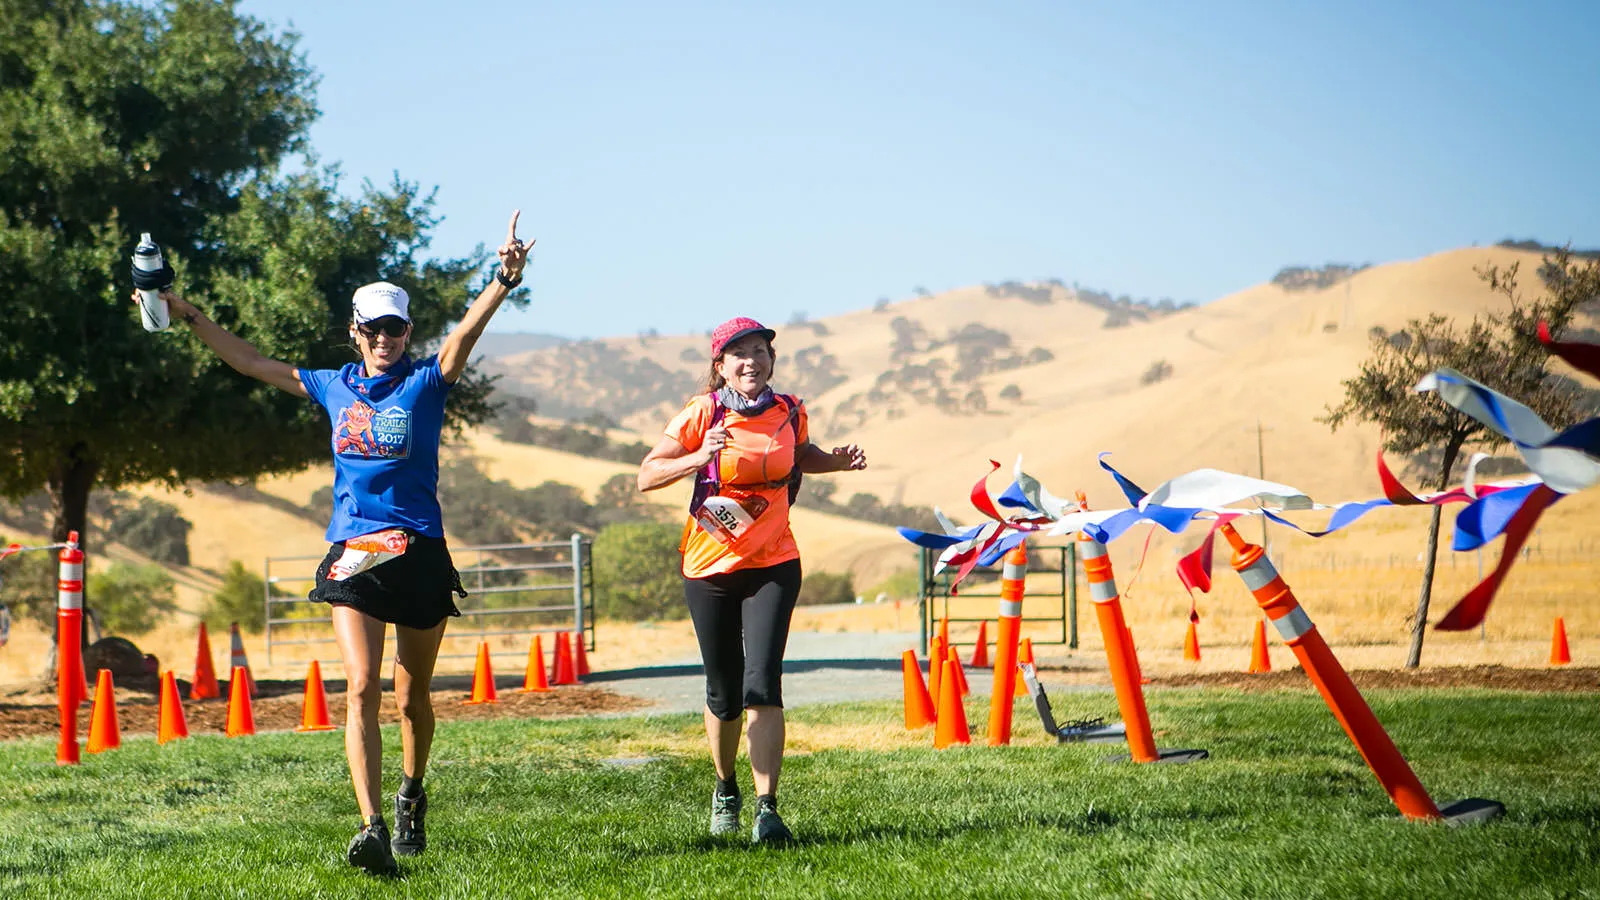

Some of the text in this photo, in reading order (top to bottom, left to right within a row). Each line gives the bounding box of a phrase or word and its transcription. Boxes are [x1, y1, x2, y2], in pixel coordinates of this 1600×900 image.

[375, 417, 407, 428] TRAILS
[377, 433, 404, 444] 2017
[715, 505, 739, 530] 3576
